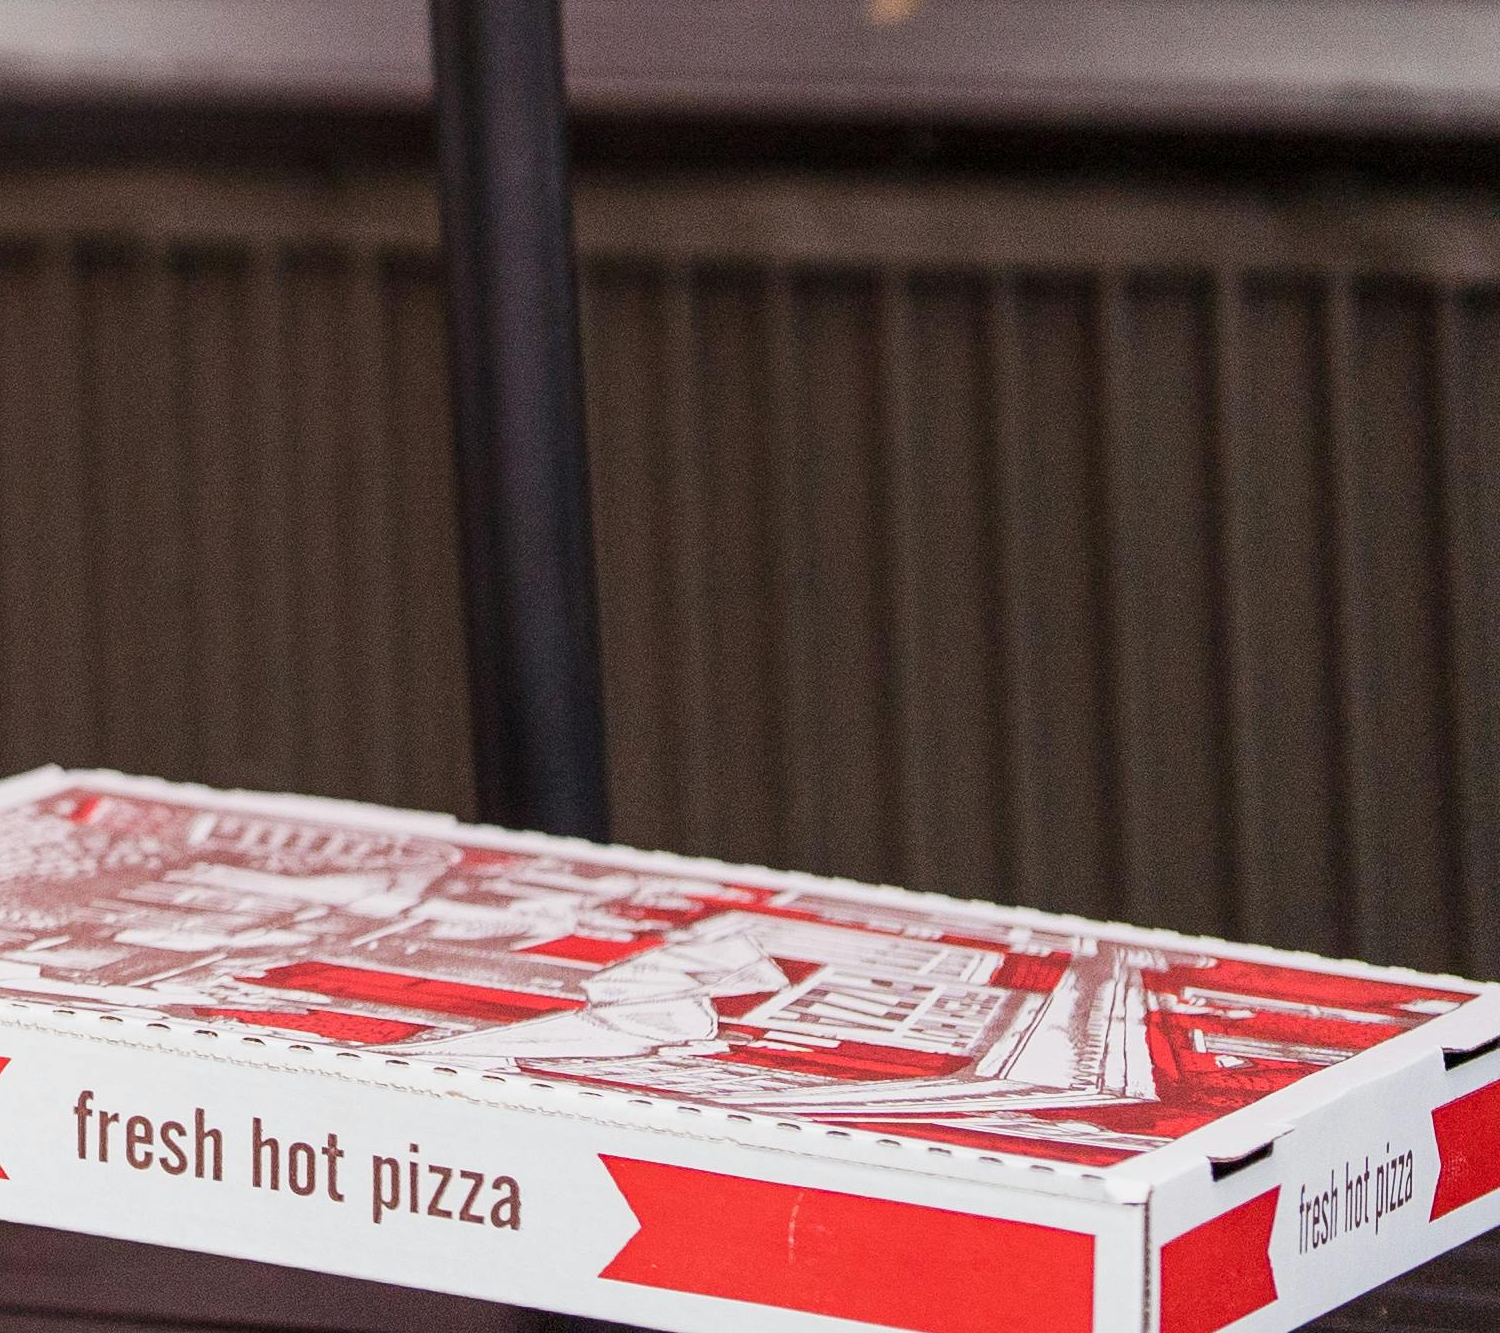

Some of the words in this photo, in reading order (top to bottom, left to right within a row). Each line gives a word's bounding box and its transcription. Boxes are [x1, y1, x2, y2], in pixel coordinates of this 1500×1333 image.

[73, 1089, 223, 1182] fresh
[252, 1116, 345, 1203] hot
[372, 1142, 523, 1232] pizza
[1299, 1168, 1338, 1255] fresh
[1344, 1161, 1370, 1233] hot
[1375, 1141, 1414, 1236] pizza
